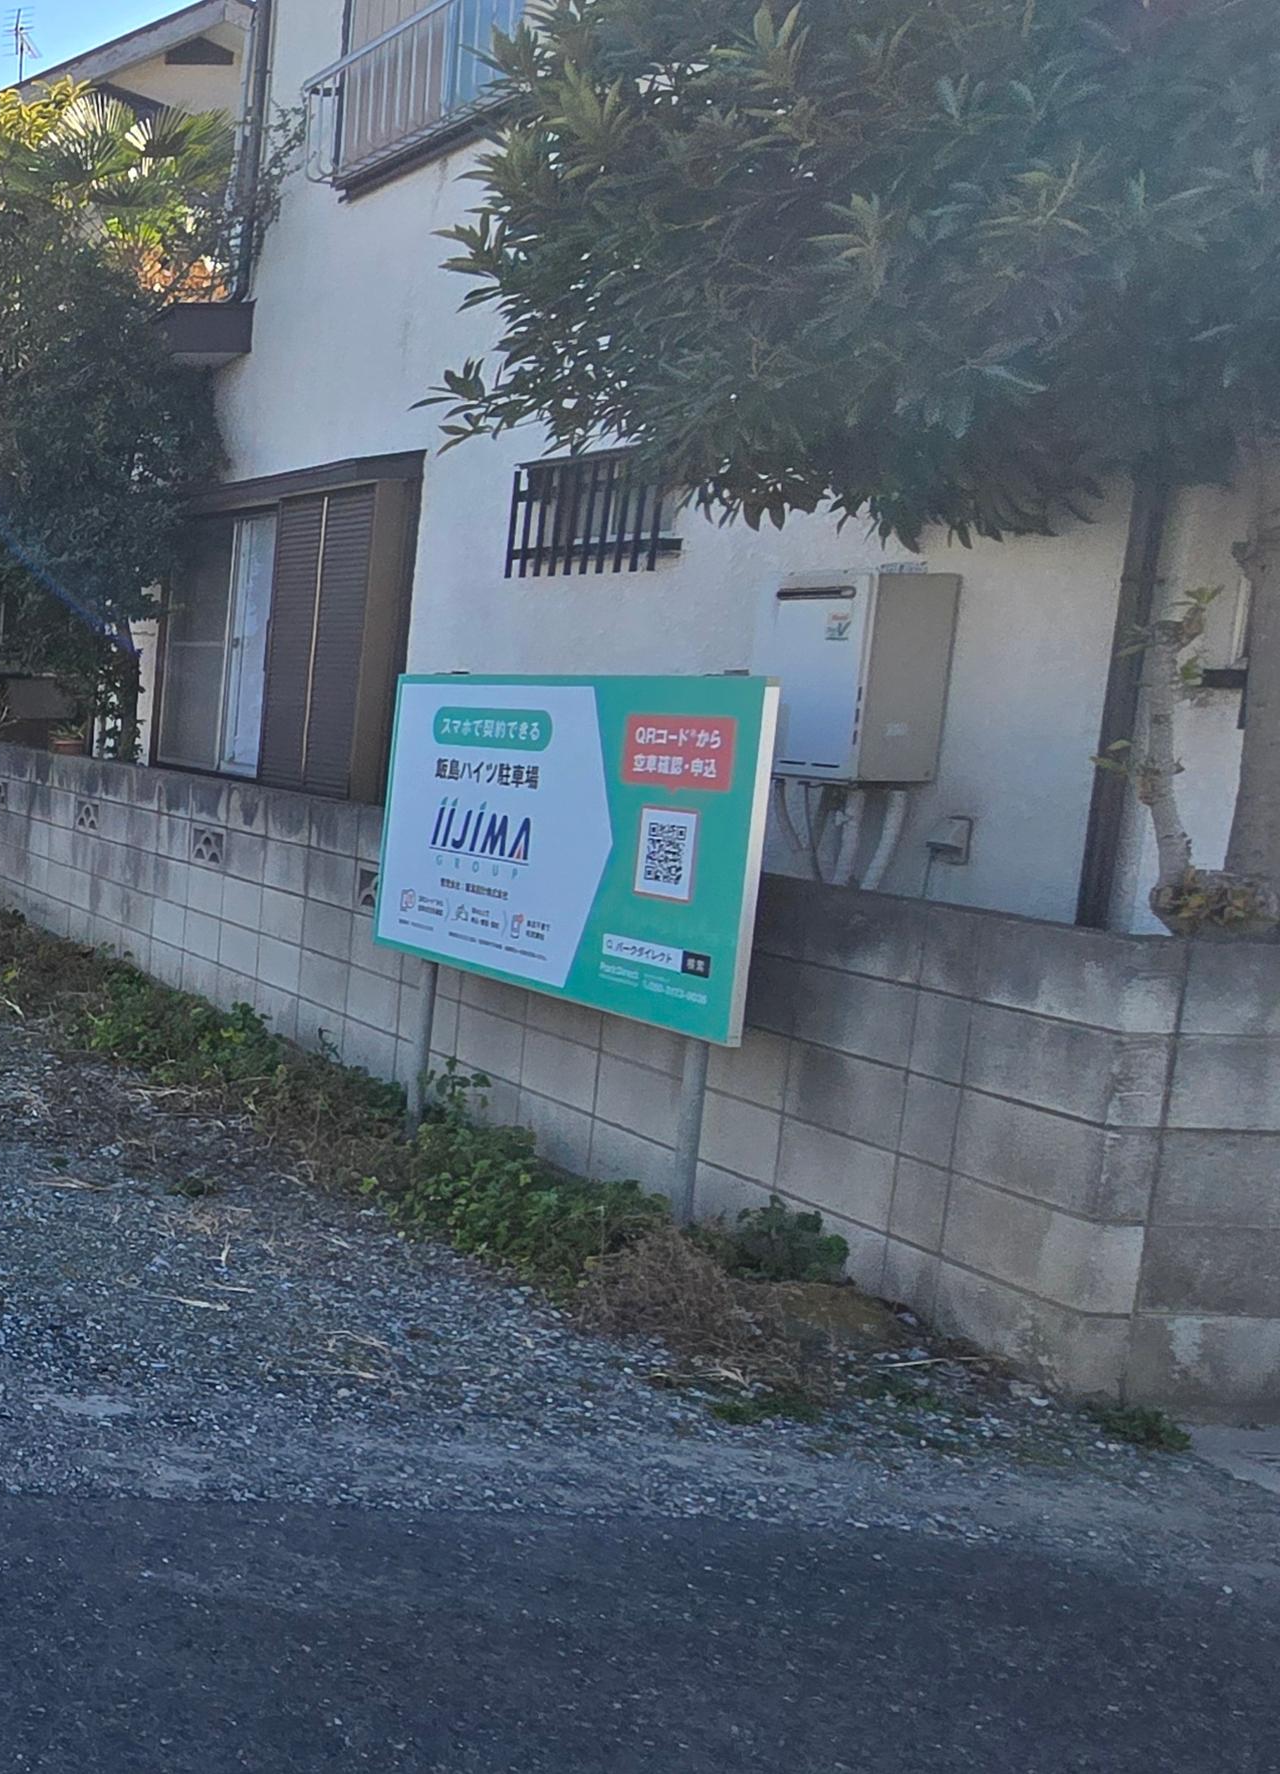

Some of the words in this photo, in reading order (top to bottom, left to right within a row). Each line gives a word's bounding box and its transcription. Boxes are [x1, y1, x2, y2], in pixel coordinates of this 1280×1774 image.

[440, 717, 540, 741] スマホで契約できる
[434, 757, 540, 790] 飯島ハイツ駐車場
[435, 854, 519, 879] GROUP
